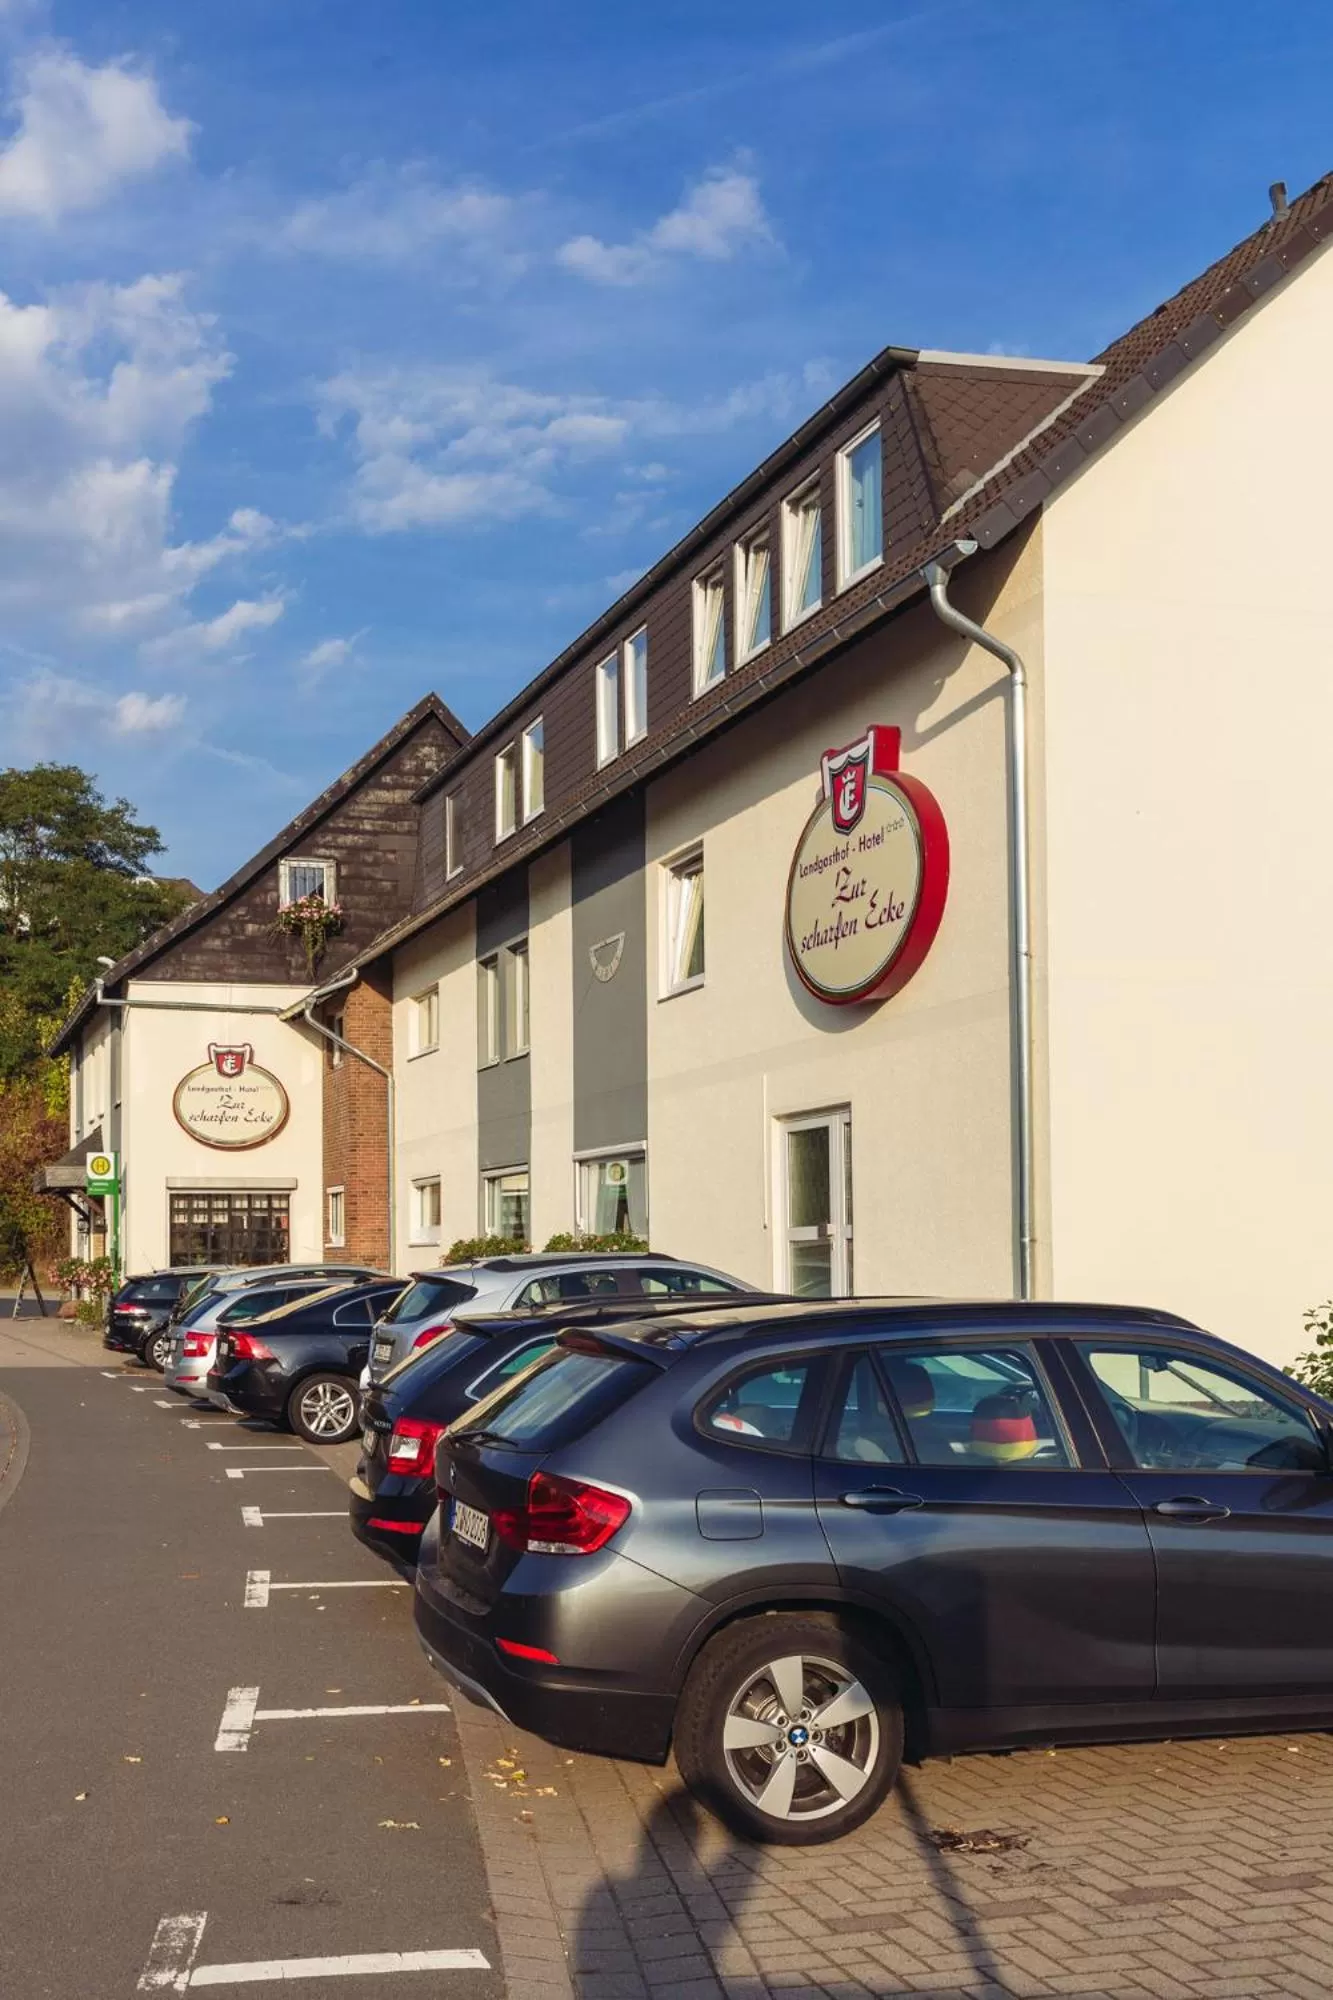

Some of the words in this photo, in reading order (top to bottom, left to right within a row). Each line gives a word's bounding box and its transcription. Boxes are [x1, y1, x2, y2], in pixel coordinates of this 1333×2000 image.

[800, 841, 850, 878] Landgasthof
[858, 826, 884, 853] Hotel
[831, 866, 867, 909] Zur
[800, 910, 858, 954] scharfen
[865, 889, 905, 929] Ecke
[189, 1109, 239, 1125] scharfen
[244, 1107, 274, 1122] Ecke
[216, 1094, 246, 1109] Zur
